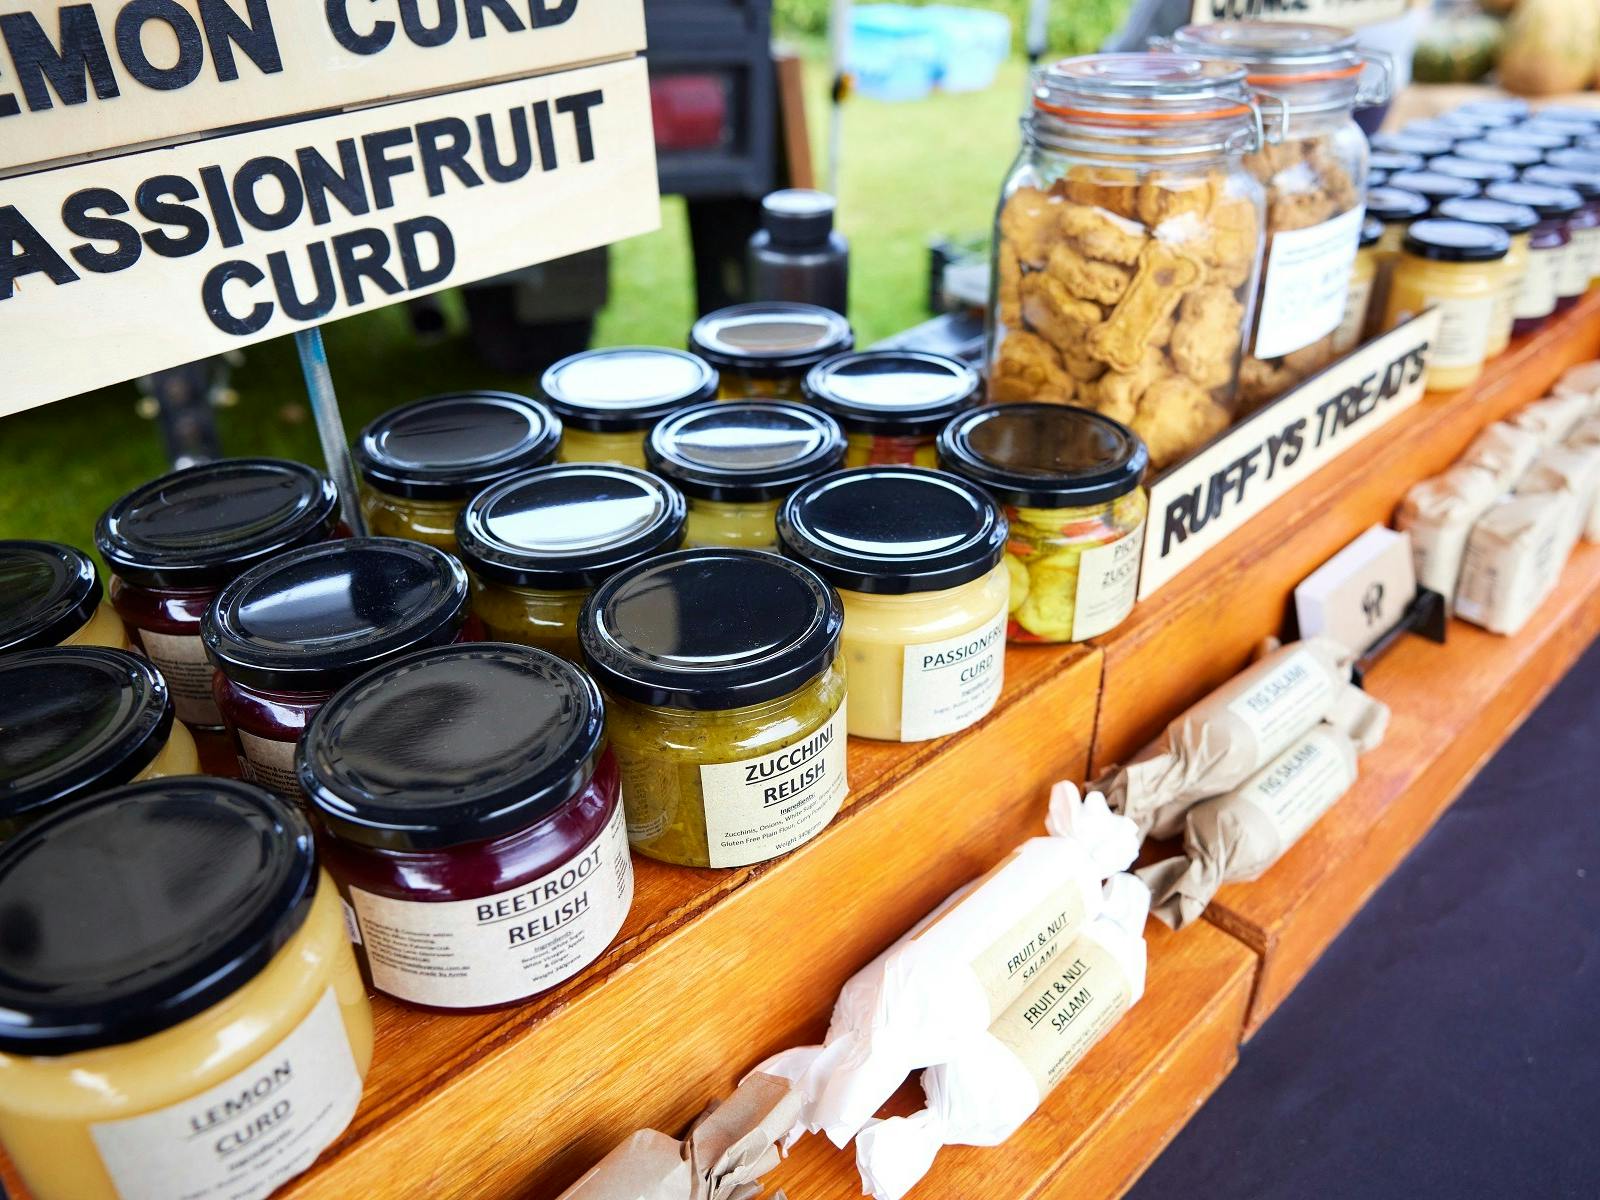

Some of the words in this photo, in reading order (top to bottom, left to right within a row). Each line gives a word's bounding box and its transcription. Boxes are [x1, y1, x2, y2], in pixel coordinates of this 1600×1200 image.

[201, 216, 456, 336] CURD
[1161, 418, 1306, 557] RUFFYS
[1315, 342, 1428, 448] TREATS
[960, 654, 993, 683] CURD
[745, 723, 833, 782] ZUCCHINI
[763, 758, 825, 804] RELISH
[477, 844, 601, 921] BEETROOT
[508, 890, 588, 945] RELISH
[1007, 940, 1038, 974] FRUIT
[1037, 932, 1047, 947] &
[1047, 911, 1068, 938] NUT
[1022, 943, 1059, 983] SALAMI
[1023, 990, 1056, 1024] FRUIT
[1053, 981, 1067, 994] &
[1063, 958, 1087, 984] NUT
[1051, 987, 1092, 1032] SALAMI
[190, 1060, 292, 1132] LEMON
[214, 1099, 291, 1154] CURD
